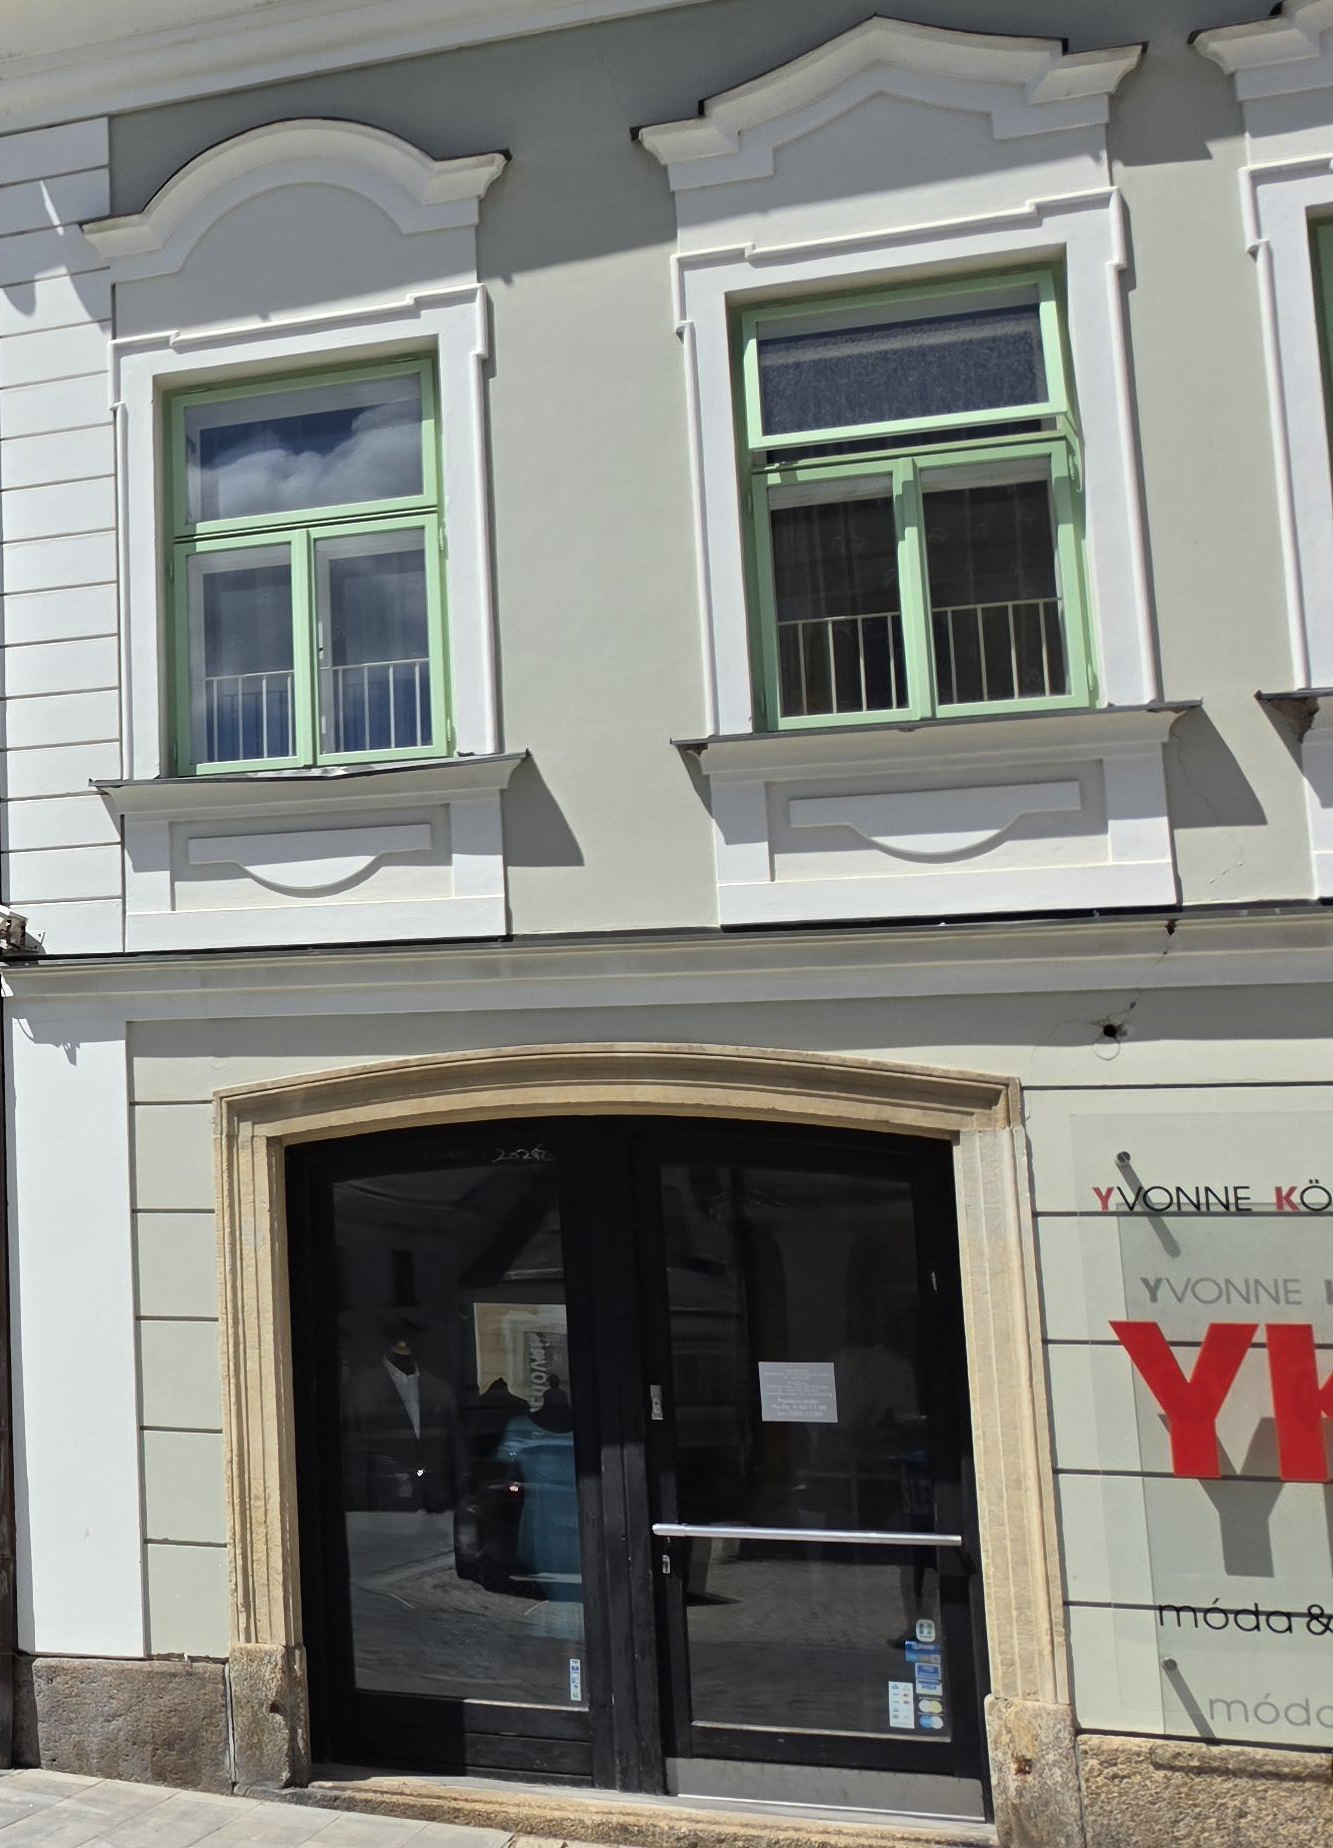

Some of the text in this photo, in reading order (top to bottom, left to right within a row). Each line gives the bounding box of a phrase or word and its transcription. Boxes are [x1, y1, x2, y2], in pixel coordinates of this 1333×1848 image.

[1092, 1178, 1333, 1212] YVONNE KÖ
[1140, 1276, 1303, 1306] YVONNE
[1158, 1598, 1333, 1636] móda &
